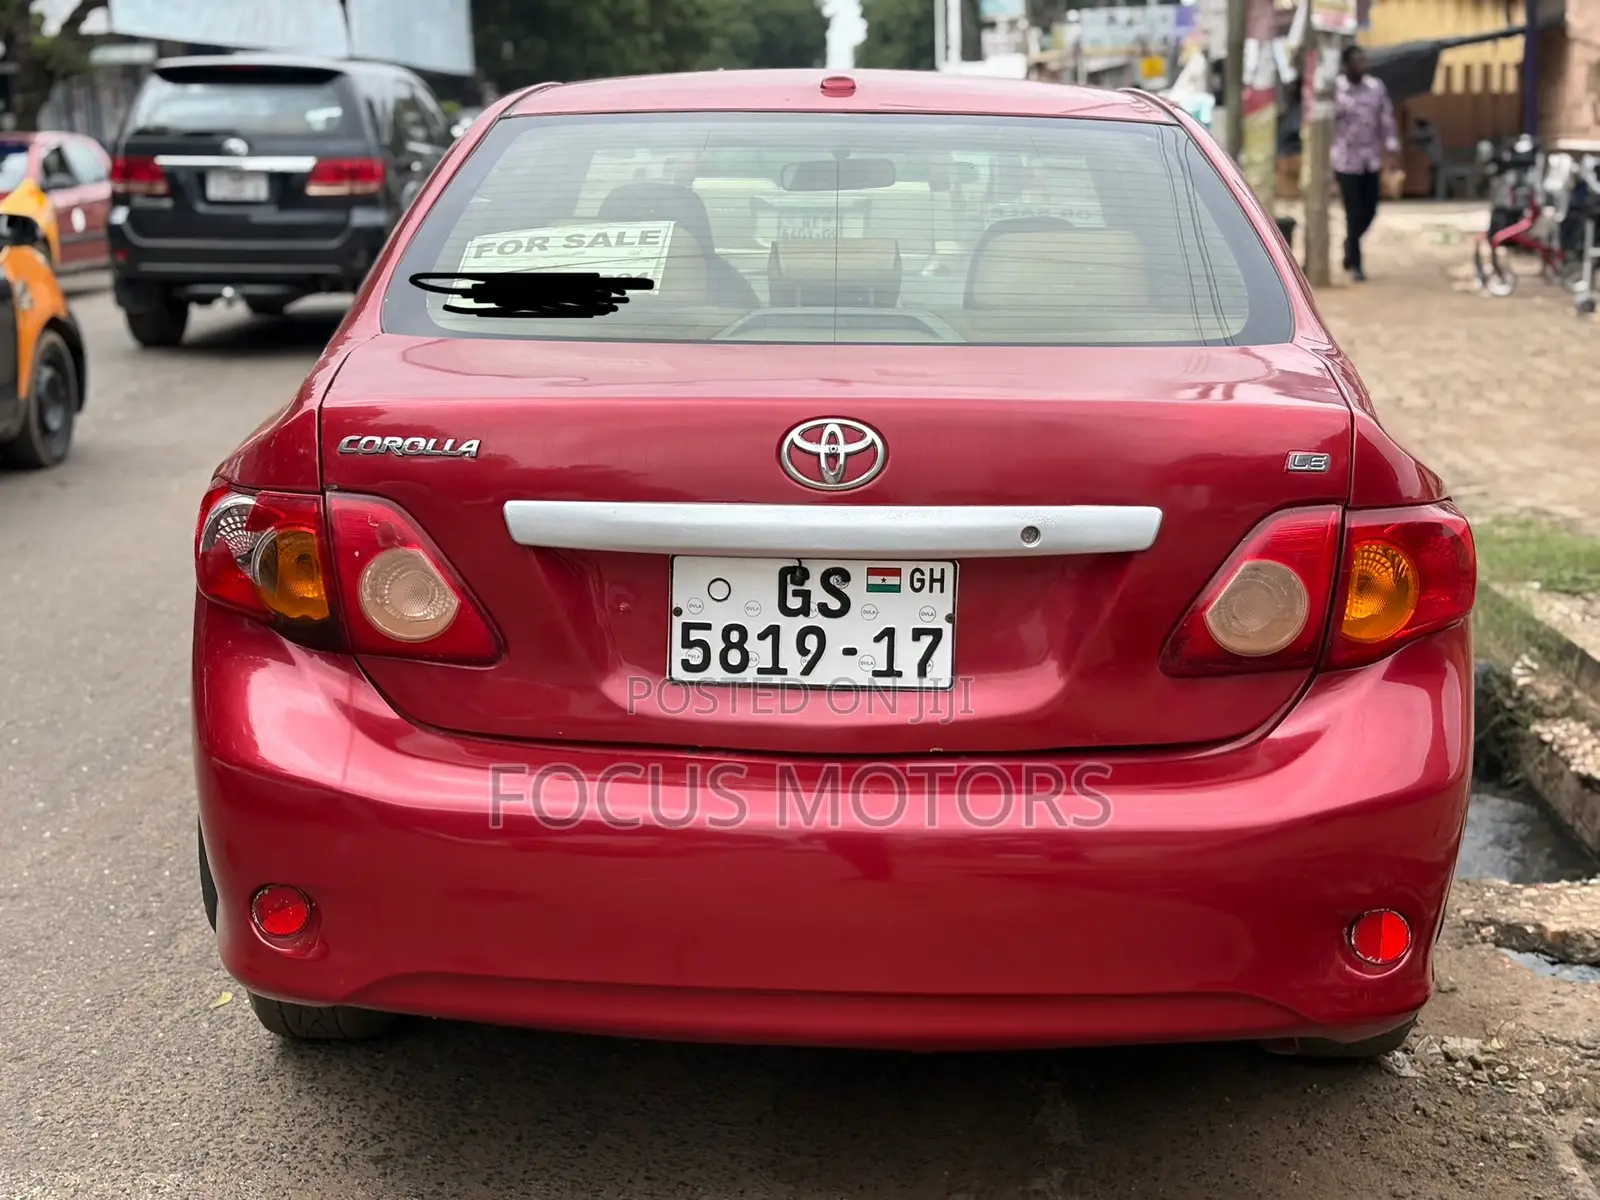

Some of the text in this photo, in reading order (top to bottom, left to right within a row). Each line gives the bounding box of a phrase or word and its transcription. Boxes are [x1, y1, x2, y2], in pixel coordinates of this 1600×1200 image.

[473, 230, 662, 259] FOR SALE
[338, 435, 481, 457] COROLLA
[1290, 453, 1328, 470] LE
[778, 565, 852, 618] GS
[909, 567, 946, 594] GH
